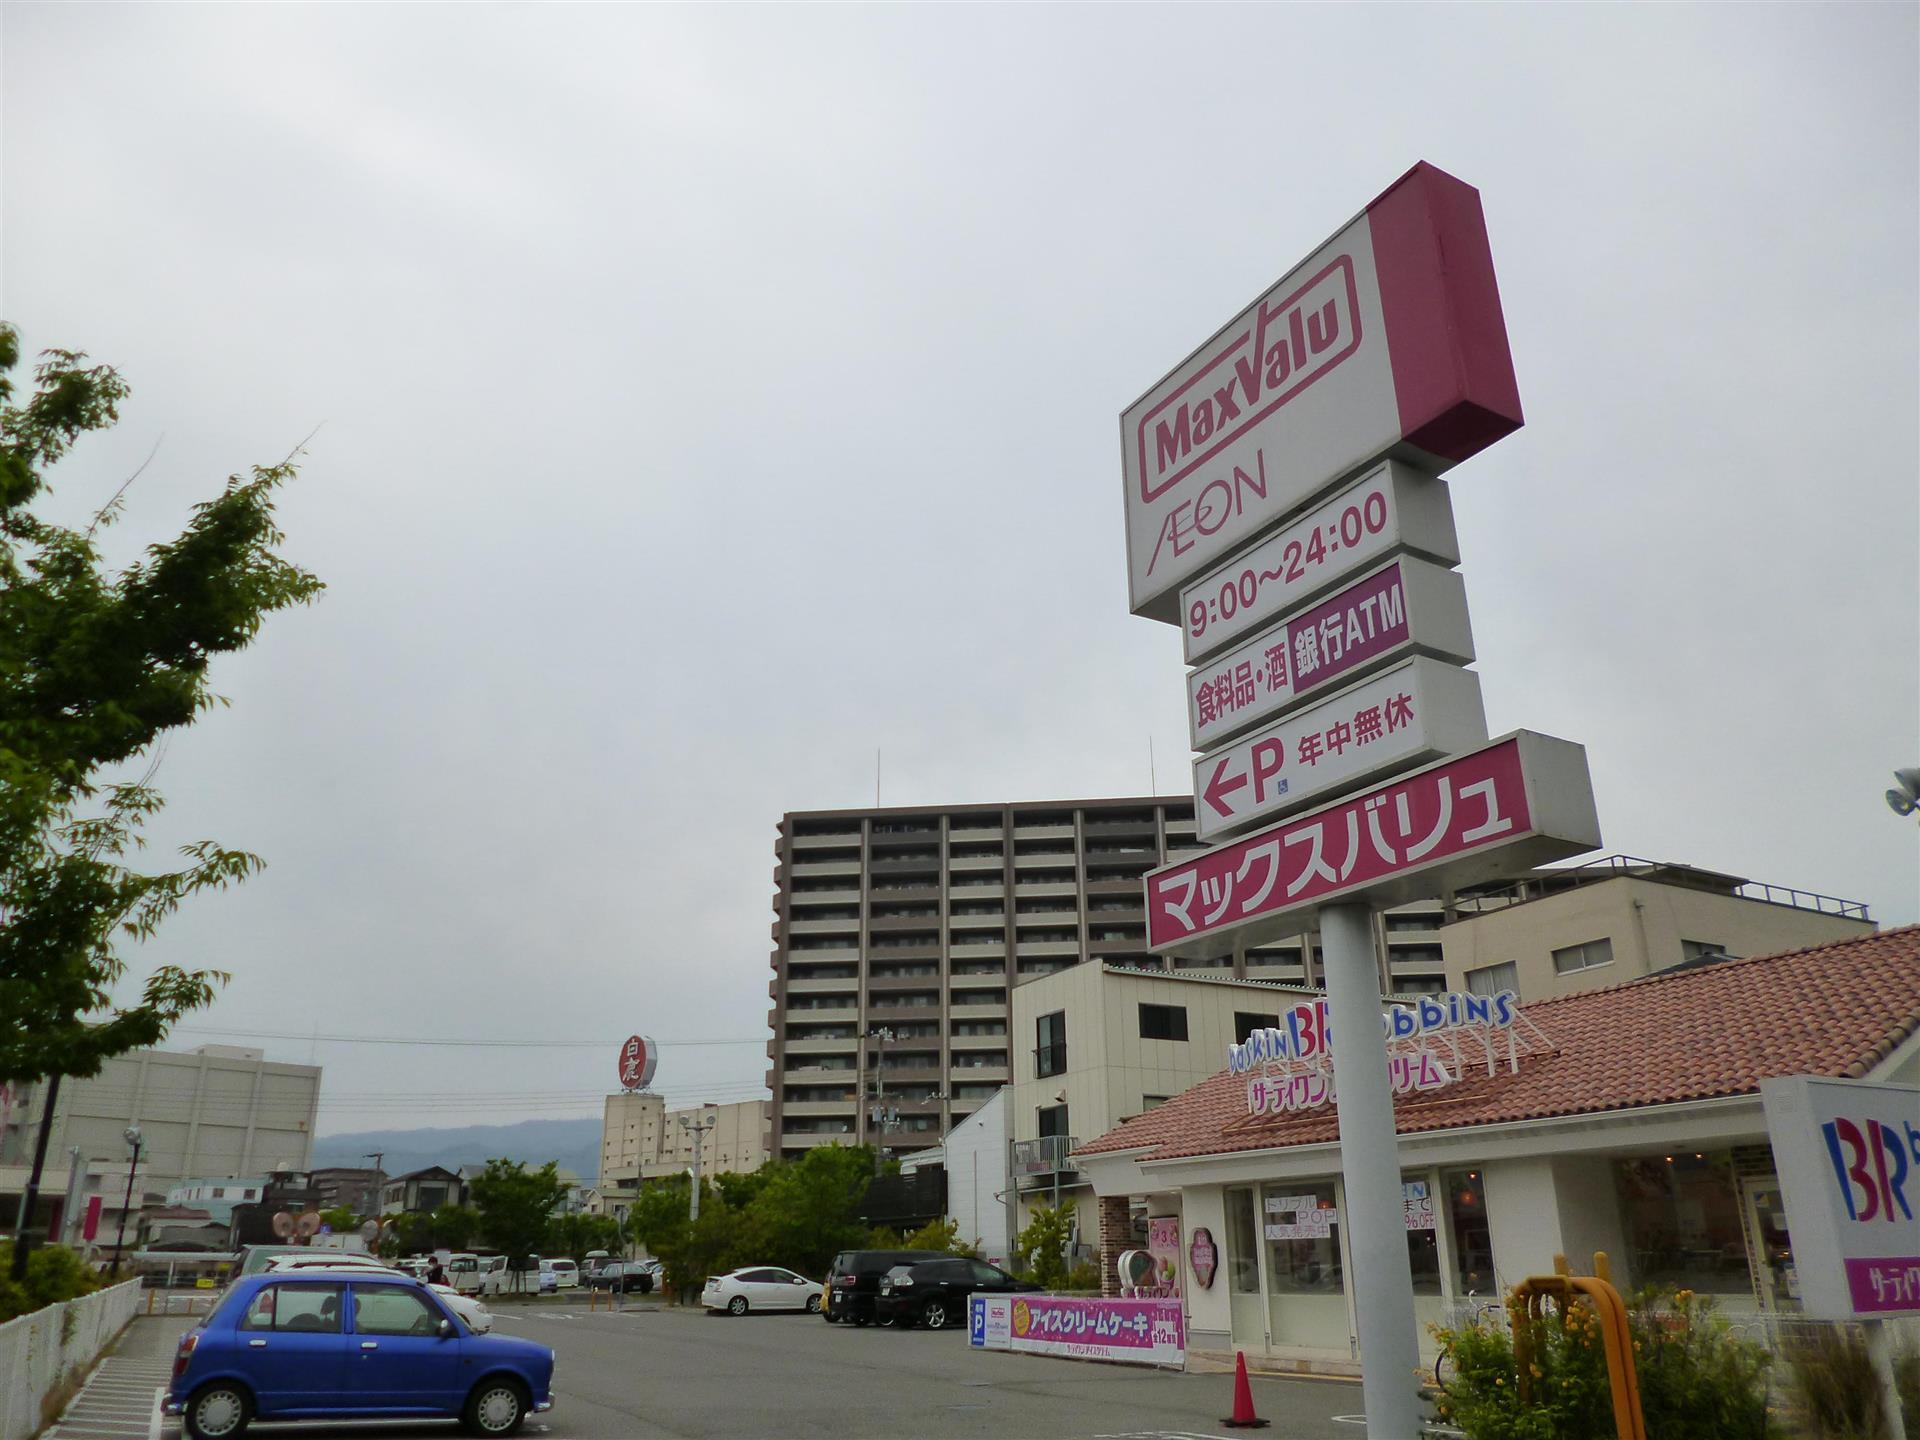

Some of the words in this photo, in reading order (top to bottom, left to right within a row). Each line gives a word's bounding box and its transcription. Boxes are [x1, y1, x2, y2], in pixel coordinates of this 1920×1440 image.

[1154, 298, 1339, 475] MaxValu
[1294, 583, 1404, 678] 銀行ATM
[1251, 737, 1285, 804] P
[1298, 692, 1415, 767] 年中無休
[1158, 776, 1513, 932] マックスバリュ
[1821, 1117, 1913, 1222] BR
[1030, 1308, 1149, 1338] アイスクリームケーキ
